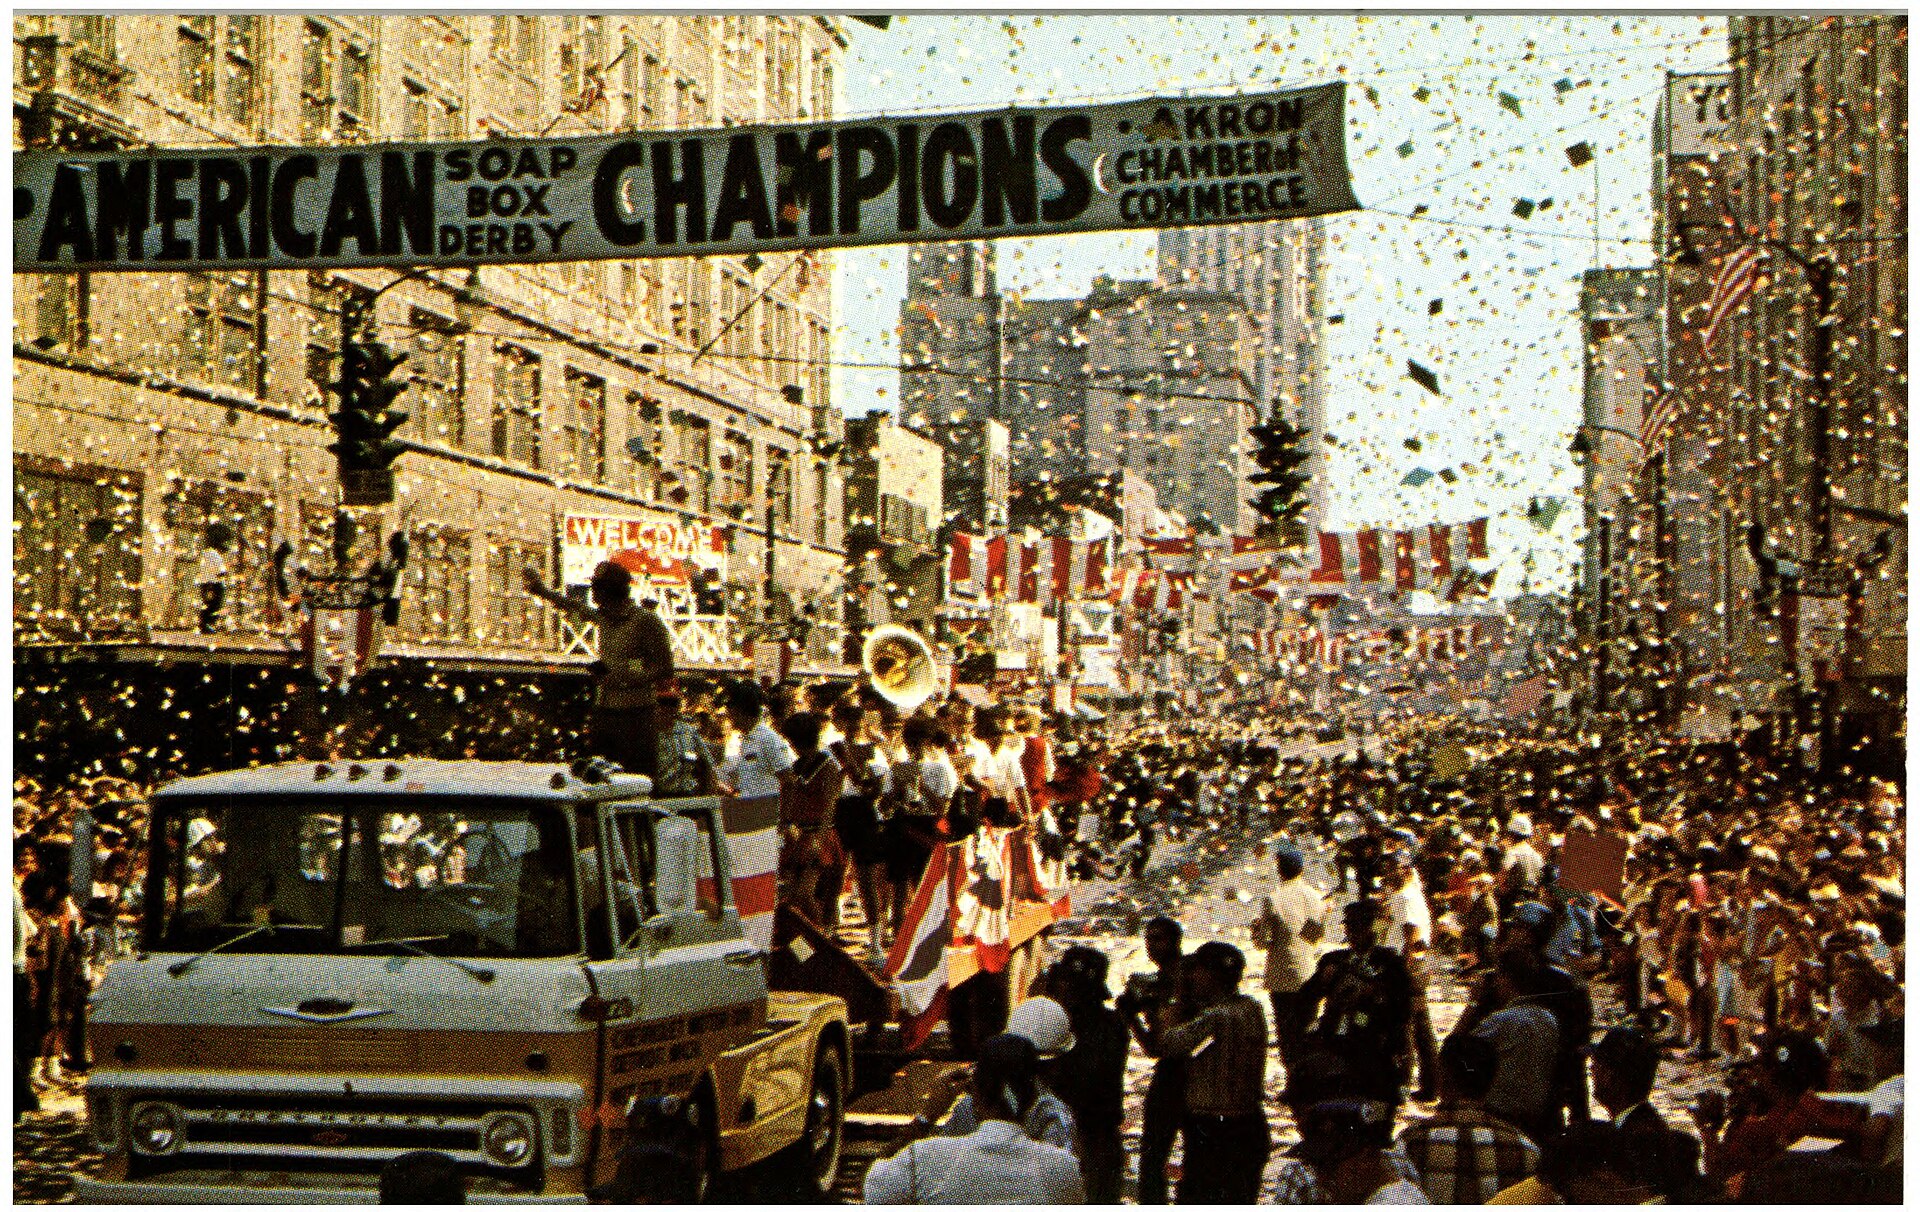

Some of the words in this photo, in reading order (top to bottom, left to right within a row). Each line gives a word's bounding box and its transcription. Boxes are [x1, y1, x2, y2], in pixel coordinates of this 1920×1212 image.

[1147, 98, 1304, 143] AKRON
[444, 146, 578, 182] SOAP
[593, 114, 1093, 247] CHAMPIONS
[37, 150, 435, 262] AMERICAN
[466, 184, 551, 218] BOX
[1119, 175, 1307, 221] COMMERCE
[439, 220, 576, 256] DERBY
[572, 517, 713, 554] WELCOME
